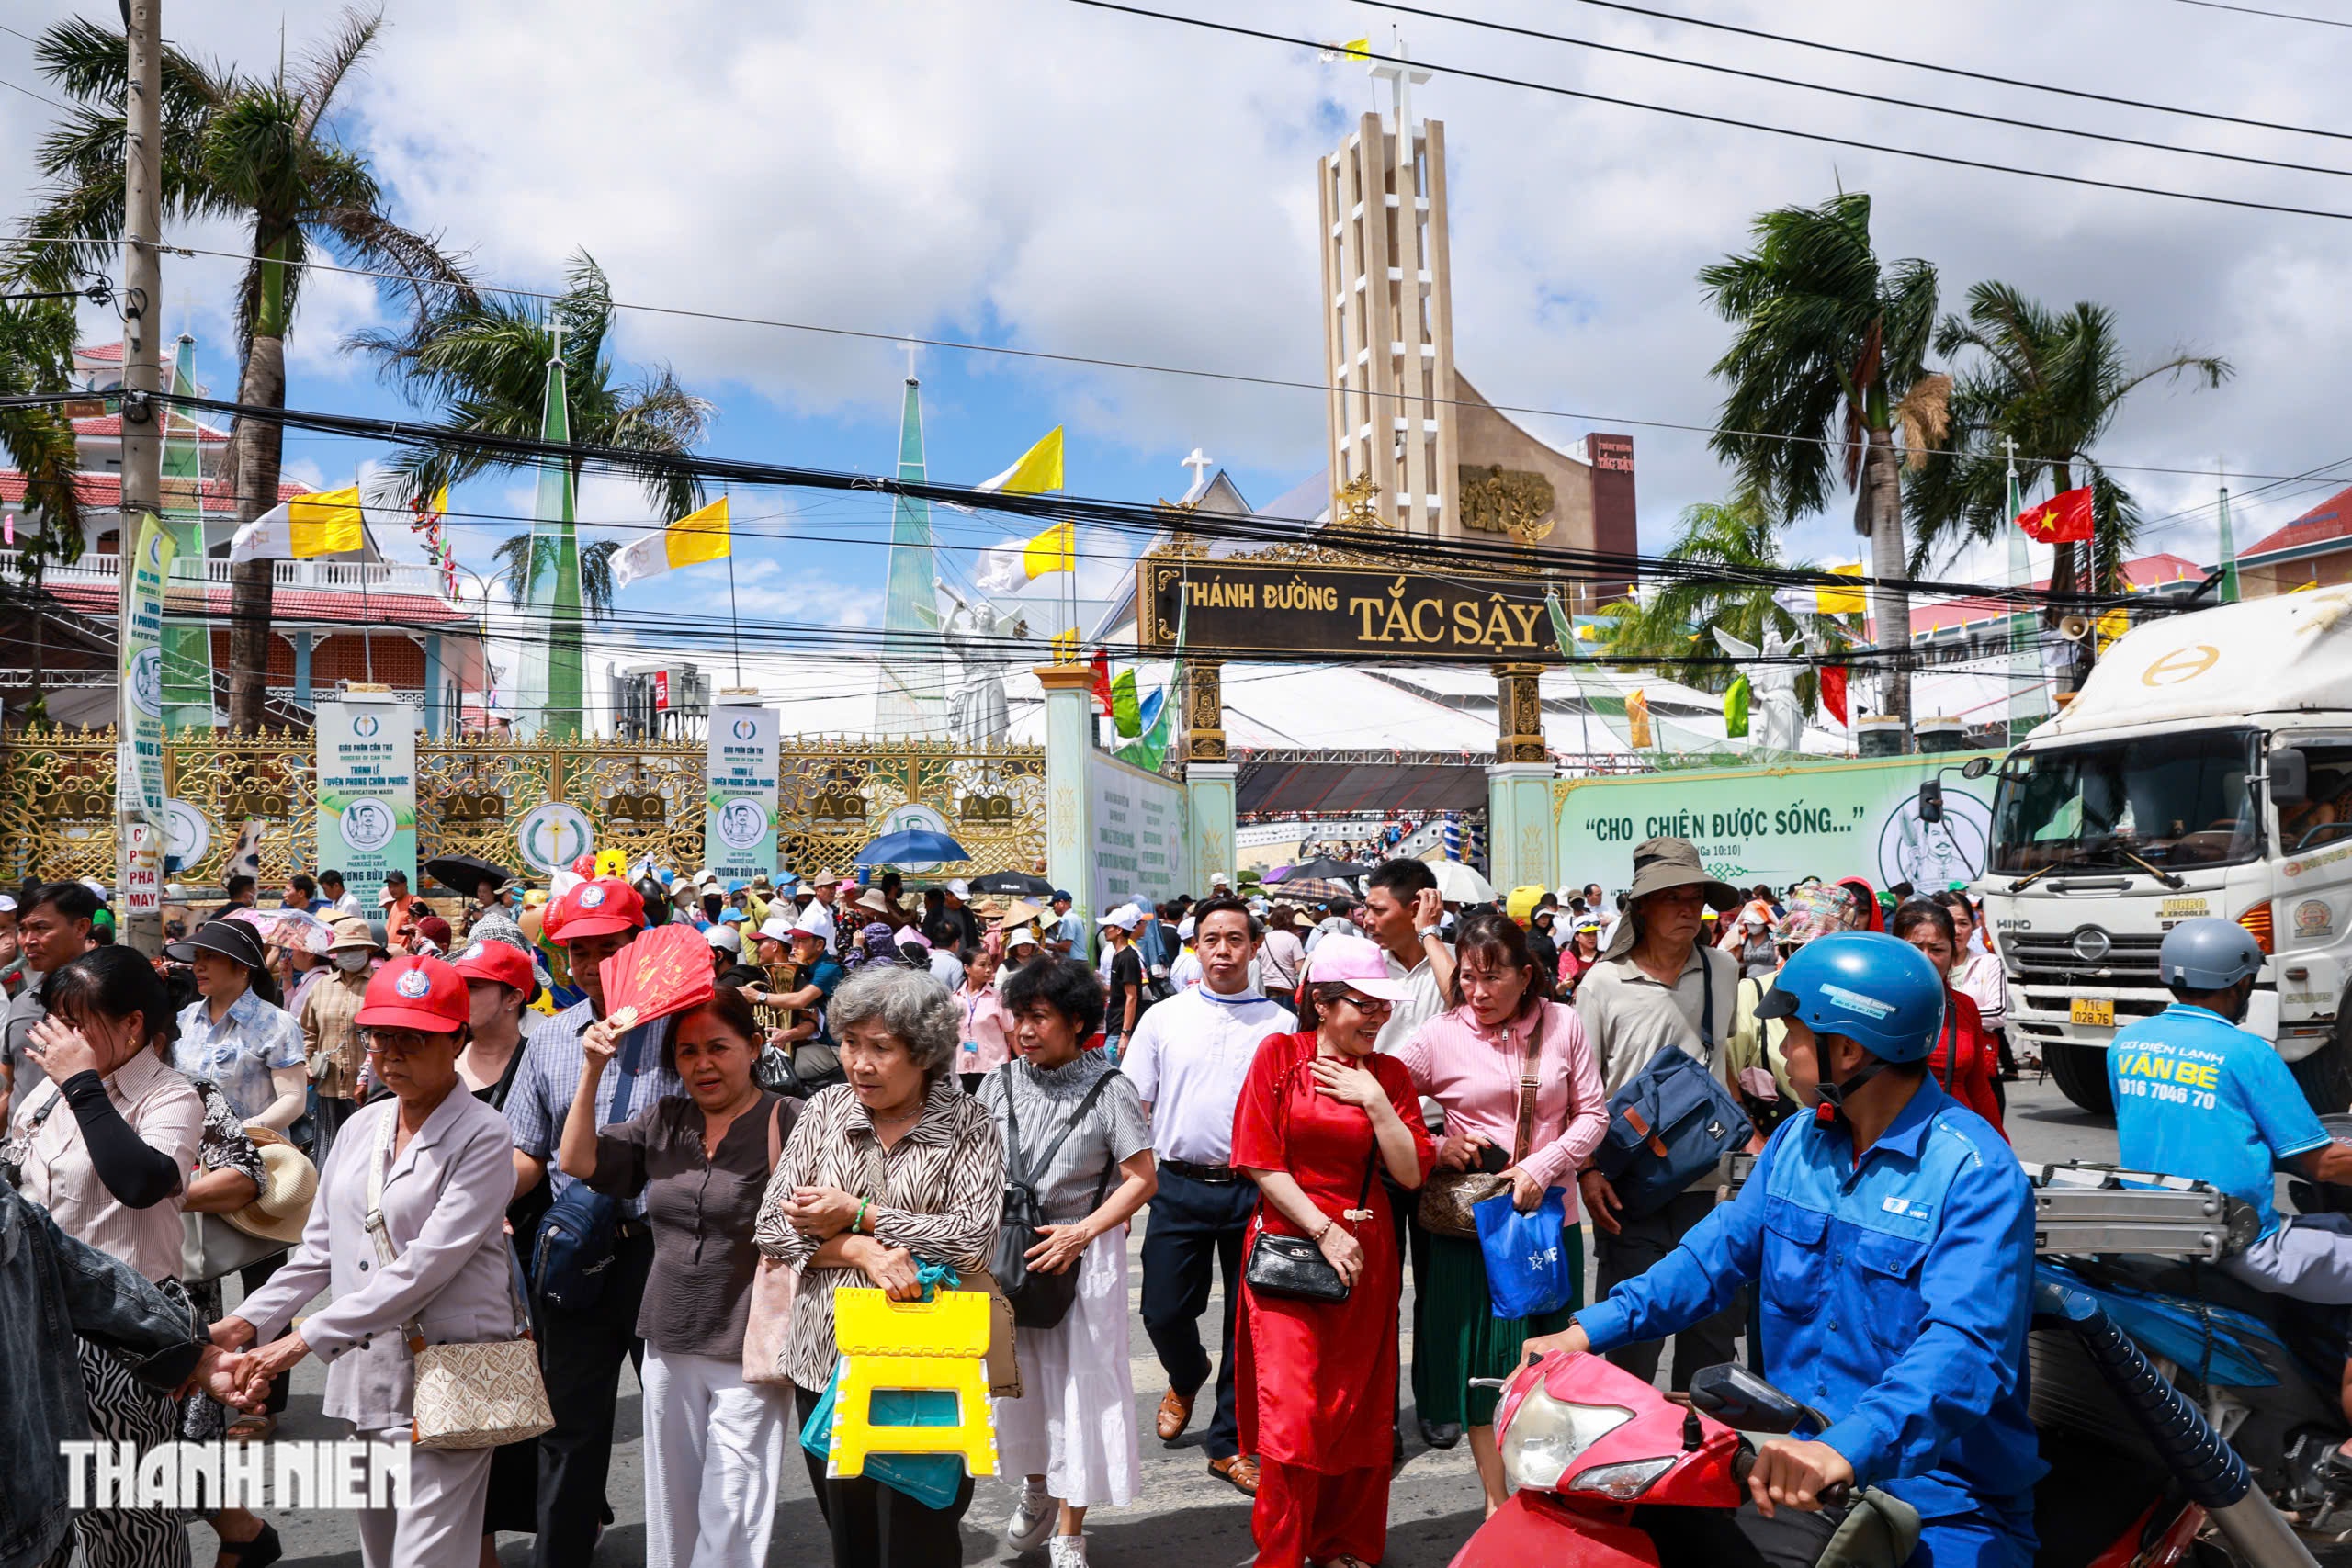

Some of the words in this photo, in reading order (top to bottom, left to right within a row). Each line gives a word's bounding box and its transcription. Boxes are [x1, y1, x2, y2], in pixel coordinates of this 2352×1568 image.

[1179, 576, 1254, 608] THÁNH
[1263, 574, 1338, 611] ĐƯỜNG
[1350, 575, 1443, 643] TẮC
[1453, 592, 1544, 653] SẬY
[350, 766, 371, 775] THÁNH
[345, 778, 367, 786] PHONG
[1586, 817, 1633, 841] “CHO
[1646, 809, 1704, 839] CHIÊN
[1712, 807, 1767, 841] ĐƯỢC
[1775, 799, 1864, 835] SỐNG...”
[1713, 845, 1741, 857] 10:10)
[130, 871, 154, 885] PHA
[368, 867, 383, 881] BỬU
[715, 866, 738, 876] TRƯƠNG
[129, 893, 156, 907] MAY
[2162, 898, 2207, 917] TURBO
[1996, 919, 2031, 929] HINO
[2075, 1011, 2109, 1024] 028.76
[2139, 1042, 2176, 1055] ĐIỆN
[2178, 1047, 2225, 1065] LẠNH
[2118, 1053, 2174, 1079] VĂN
[2175, 1061, 2220, 1090] BÉ
[2150, 1082, 2188, 1103] 7046
[2192, 1090, 2215, 1110] 70
